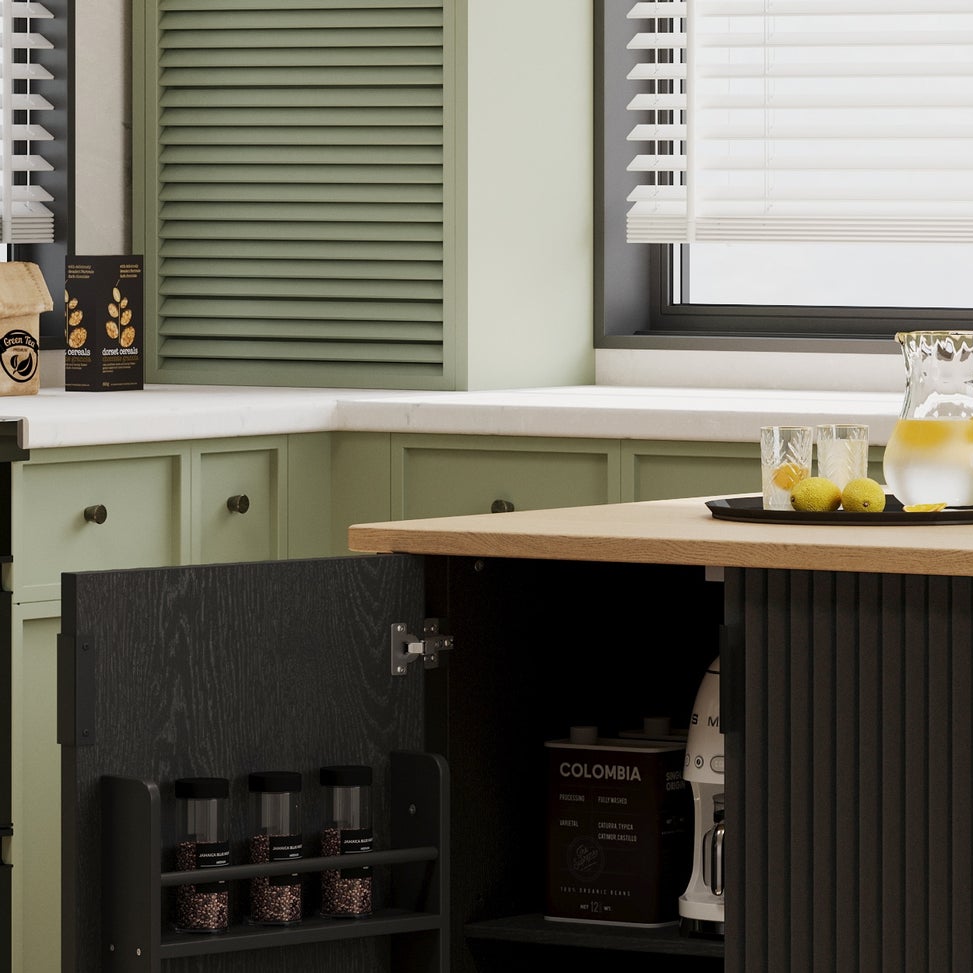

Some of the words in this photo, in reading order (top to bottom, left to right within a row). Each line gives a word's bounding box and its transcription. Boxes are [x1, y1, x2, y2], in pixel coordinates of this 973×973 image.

[4, 337, 23, 347] Green
[24, 335, 35, 348] Tea
[67, 347, 91, 356] cereals
[102, 348, 119, 356] dorset
[120, 346, 138, 355] cereals
[559, 762, 642, 782] COLOMBIA
[559, 793, 585, 802] PROCESSING
[559, 819, 579, 828] VARIETAL
